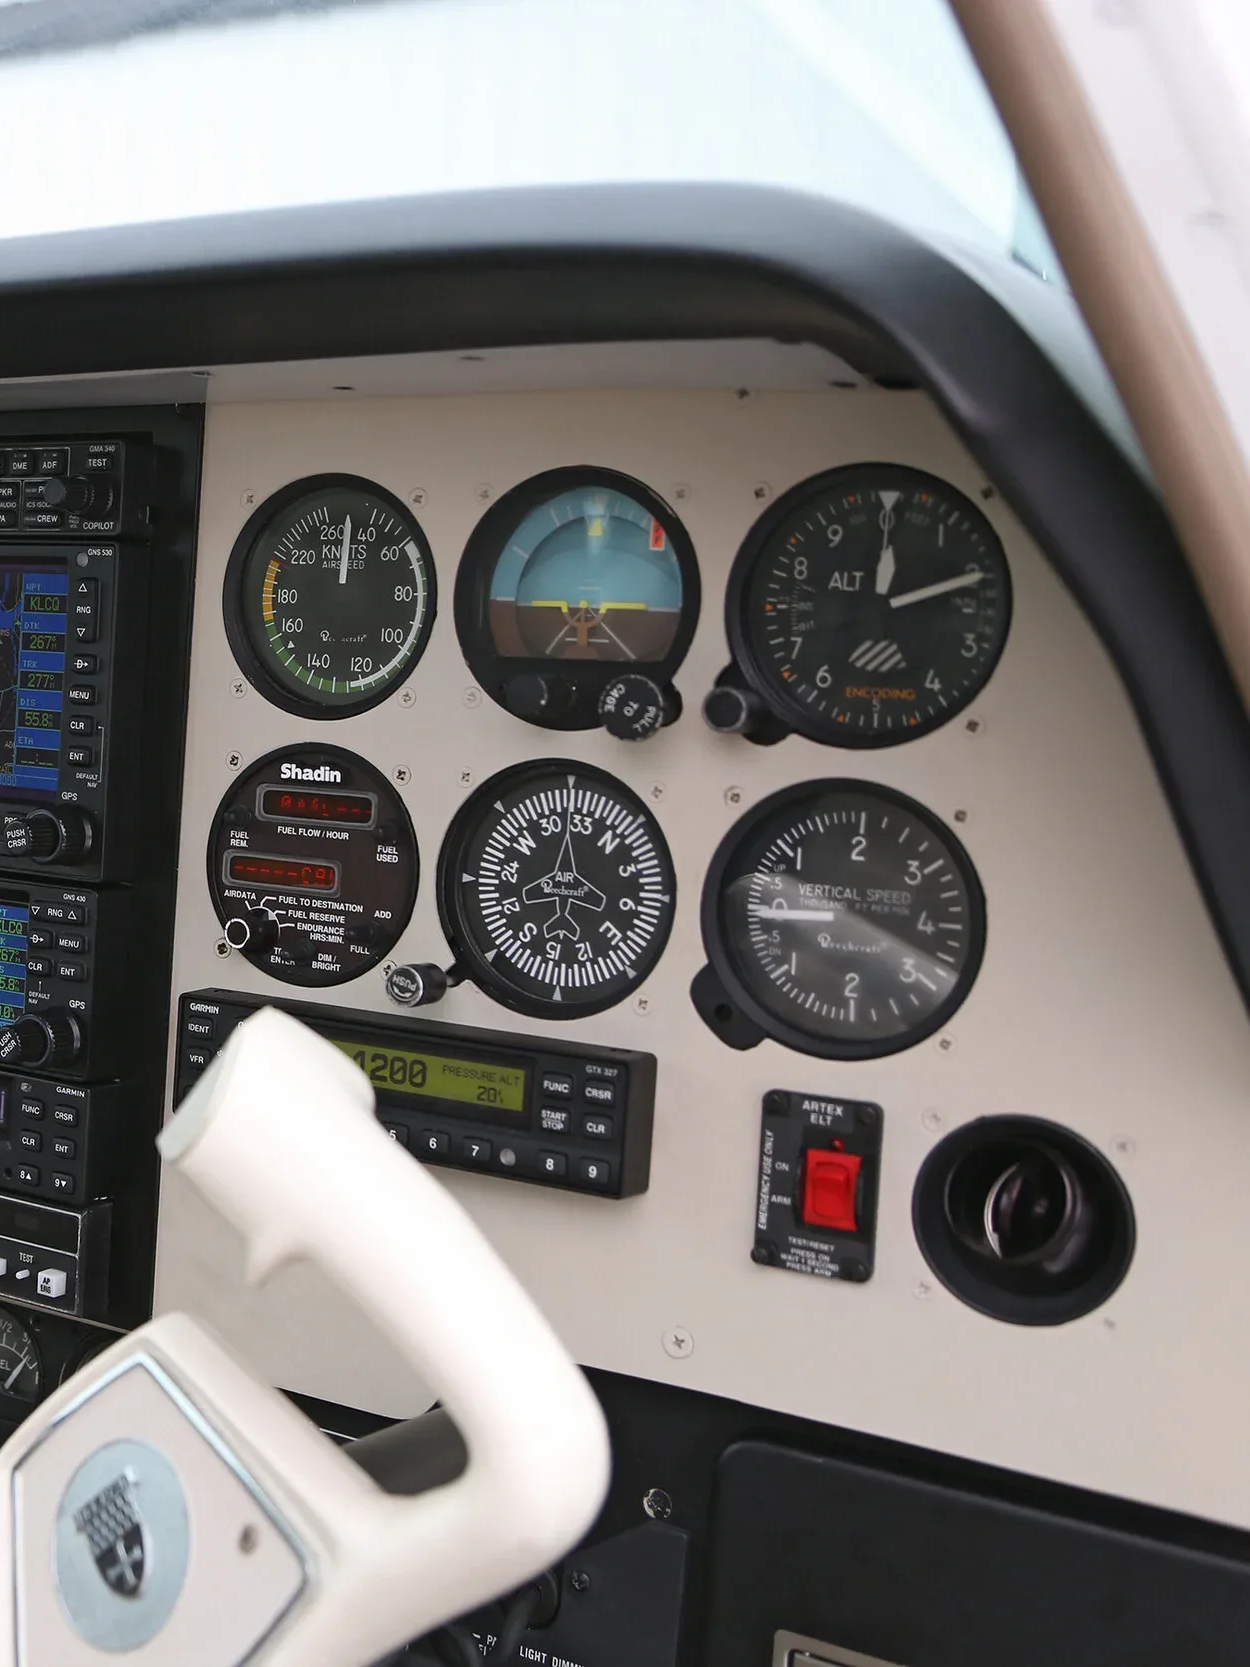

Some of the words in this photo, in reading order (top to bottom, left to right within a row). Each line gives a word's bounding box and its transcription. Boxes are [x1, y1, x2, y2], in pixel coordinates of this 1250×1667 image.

[12, 462, 27, 470] DME
[42, 461, 58, 469] ADF
[88, 458, 108, 466] TEST
[37, 515, 58, 523] CREW
[83, 522, 114, 530] COPILOT
[320, 526, 345, 540] 260
[358, 528, 376, 542] 40
[826, 524, 843, 548] 9
[291, 550, 315, 564] 220
[322, 544, 367, 560] KNTS
[380, 546, 399, 561] 60
[322, 560, 365, 570] AIRSEED
[794, 557, 808, 580] 8
[828, 571, 864, 591] ALT
[278, 589, 298, 604] 180
[394, 586, 412, 602] 80
[76, 606, 91, 614] RNG
[282, 618, 303, 632] 160
[380, 628, 403, 643] 100
[790, 637, 802, 659] 7
[960, 634, 978, 658] 3
[307, 654, 330, 668] 140
[350, 657, 372, 672] 120
[816, 664, 832, 688] 6
[924, 669, 942, 691] 4
[69, 690, 90, 700] MENU
[846, 686, 915, 700] ENCODING
[623, 700, 639, 717] TO
[70, 721, 84, 730] CLR
[69, 752, 84, 761] ENT
[280, 762, 342, 782] Shadin
[61, 792, 78, 802] GPS
[539, 815, 561, 836] 30
[570, 814, 593, 835] 33
[6, 828, 25, 839] PUSH
[230, 830, 249, 839] FUEL
[278, 826, 297, 836] FUEL
[298, 828, 320, 838] FLOW
[326, 830, 349, 840] HOUR
[8, 838, 26, 849] CRSR
[230, 838, 248, 848] REM.
[512, 830, 536, 855] W
[598, 830, 620, 855] N
[851, 836, 866, 861] 2
[377, 845, 398, 854] FUEL
[376, 853, 398, 863] USED
[502, 860, 519, 883] 24
[555, 871, 574, 883] AIR
[619, 864, 636, 877] 3
[904, 860, 922, 885] 3
[224, 890, 256, 900] AIRDATA
[799, 884, 861, 900] VERTICAL
[866, 889, 911, 905] SPEED
[278, 896, 298, 905] FUEL
[300, 898, 310, 906] TO
[312, 899, 363, 912] DESTINATION
[502, 898, 520, 914] 21
[619, 898, 635, 911] 6
[48, 908, 63, 917] RNG
[288, 910, 308, 919] FUEL
[309, 912, 345, 924] RESERVE
[374, 910, 392, 919] ADD
[297, 922, 344, 936] ENDURANCE
[917, 911, 935, 934] 4
[310, 932, 344, 944] HRS:MIN.
[519, 922, 538, 943] S
[599, 920, 622, 945] E
[59, 938, 79, 948] MENU
[350, 945, 370, 954] FULL
[546, 941, 561, 960] 15
[575, 941, 593, 961] 12
[318, 954, 332, 962] DIM
[28, 962, 42, 971] CLR
[61, 967, 75, 976] ENT
[312, 962, 341, 972] BRIGHT
[899, 958, 917, 983] 3
[844, 973, 859, 997] 2
[69, 999, 85, 1010] GPS
[190, 1003, 219, 1014] GARMIN
[188, 1024, 209, 1034] IDENT
[190, 1054, 204, 1064] VFR
[442, 1065, 496, 1083] PRESSURE
[501, 1076, 520, 1086] ALT
[586, 1064, 602, 1074] GTX
[604, 1068, 618, 1077] 327
[56, 1086, 85, 1098] GARMIN
[544, 1080, 569, 1093] FUNC
[586, 1087, 611, 1100] CRSR
[21, 1104, 40, 1115] FUNC
[802, 1100, 844, 1117] ARTEX
[54, 1111, 73, 1122] CRSR
[541, 1110, 566, 1121] START
[810, 1113, 832, 1126] ELT
[542, 1120, 564, 1131] STOP
[587, 1122, 605, 1134] CLR
[22, 1137, 36, 1146] CLR
[430, 1138, 437, 1149] 6
[55, 1144, 69, 1153] ENT
[472, 1146, 479, 1157] 7
[546, 1158, 554, 1170] 8
[775, 1162, 789, 1172] ON
[588, 1166, 597, 1178] 9
[771, 1195, 791, 1205] ARM
[19, 1252, 33, 1264] TEST
[520, 1646, 548, 1663] LIGHT
